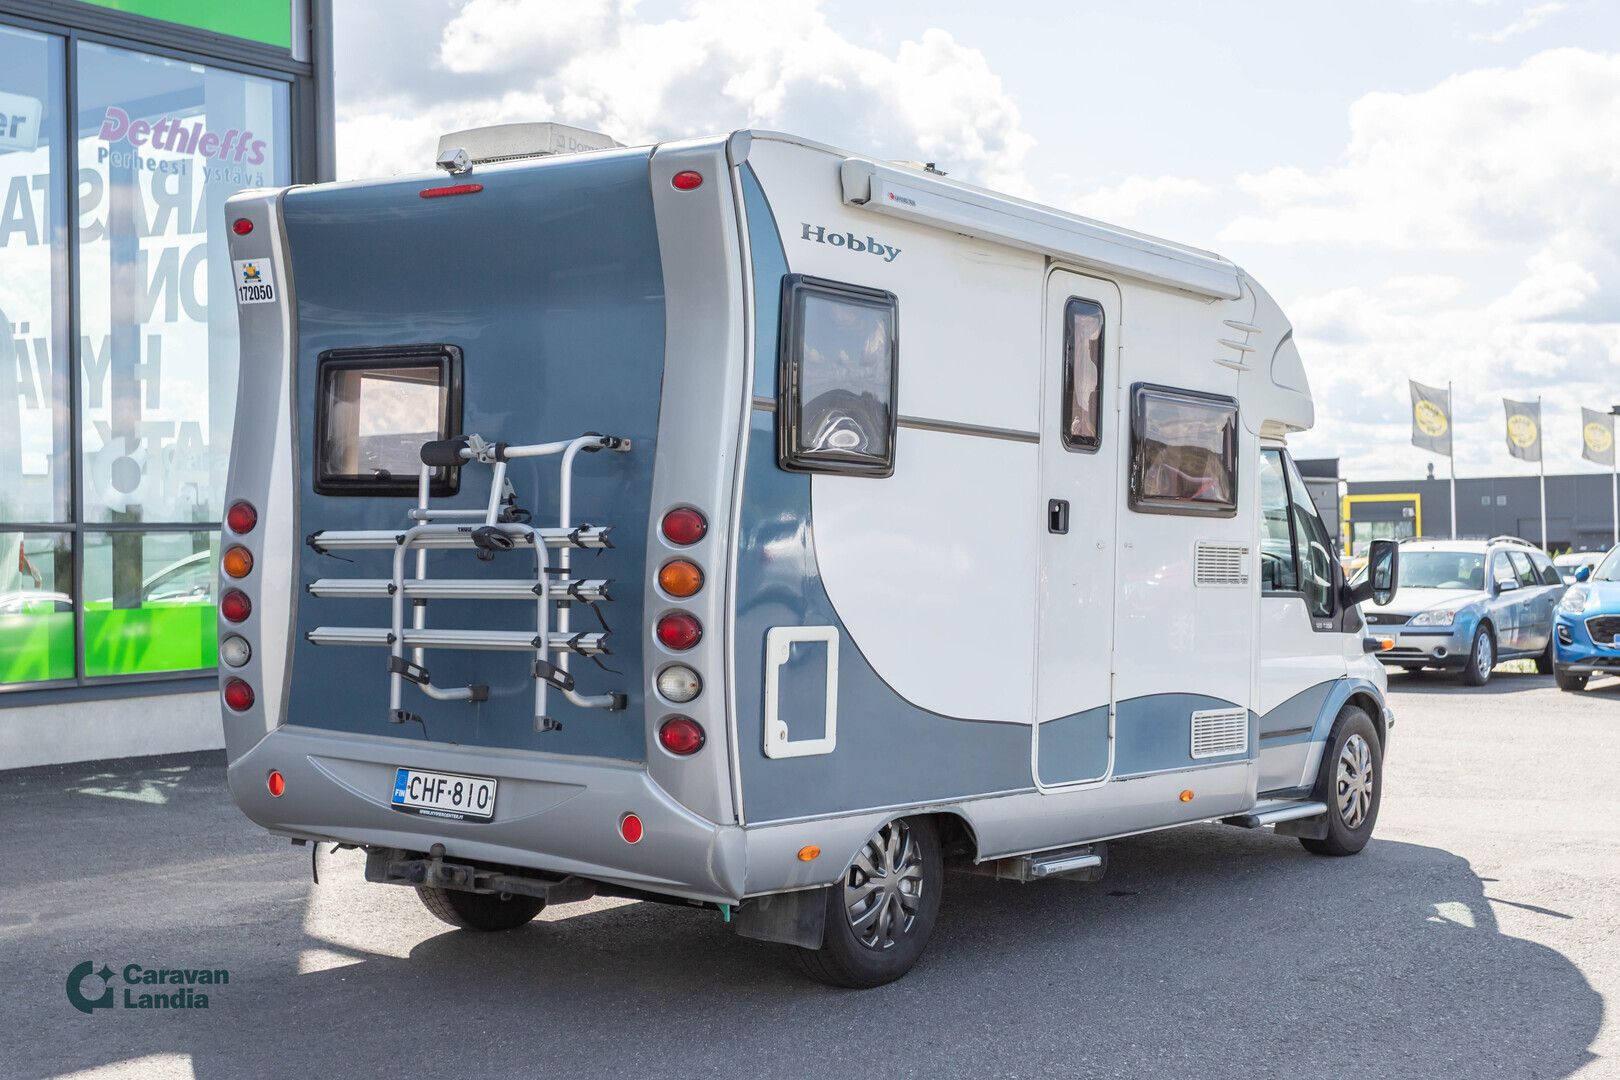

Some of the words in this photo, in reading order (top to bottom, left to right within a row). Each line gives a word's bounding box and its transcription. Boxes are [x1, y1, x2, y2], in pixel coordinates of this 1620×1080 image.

[98, 106, 267, 166] Dethleffs
[98, 147, 186, 176] Perheesi
[203, 166, 264, 187] ystävä
[801, 222, 902, 263] Hobby
[239, 285, 273, 301] 172050
[395, 789, 405, 797] FIN
[410, 776, 489, 809] CHF-810
